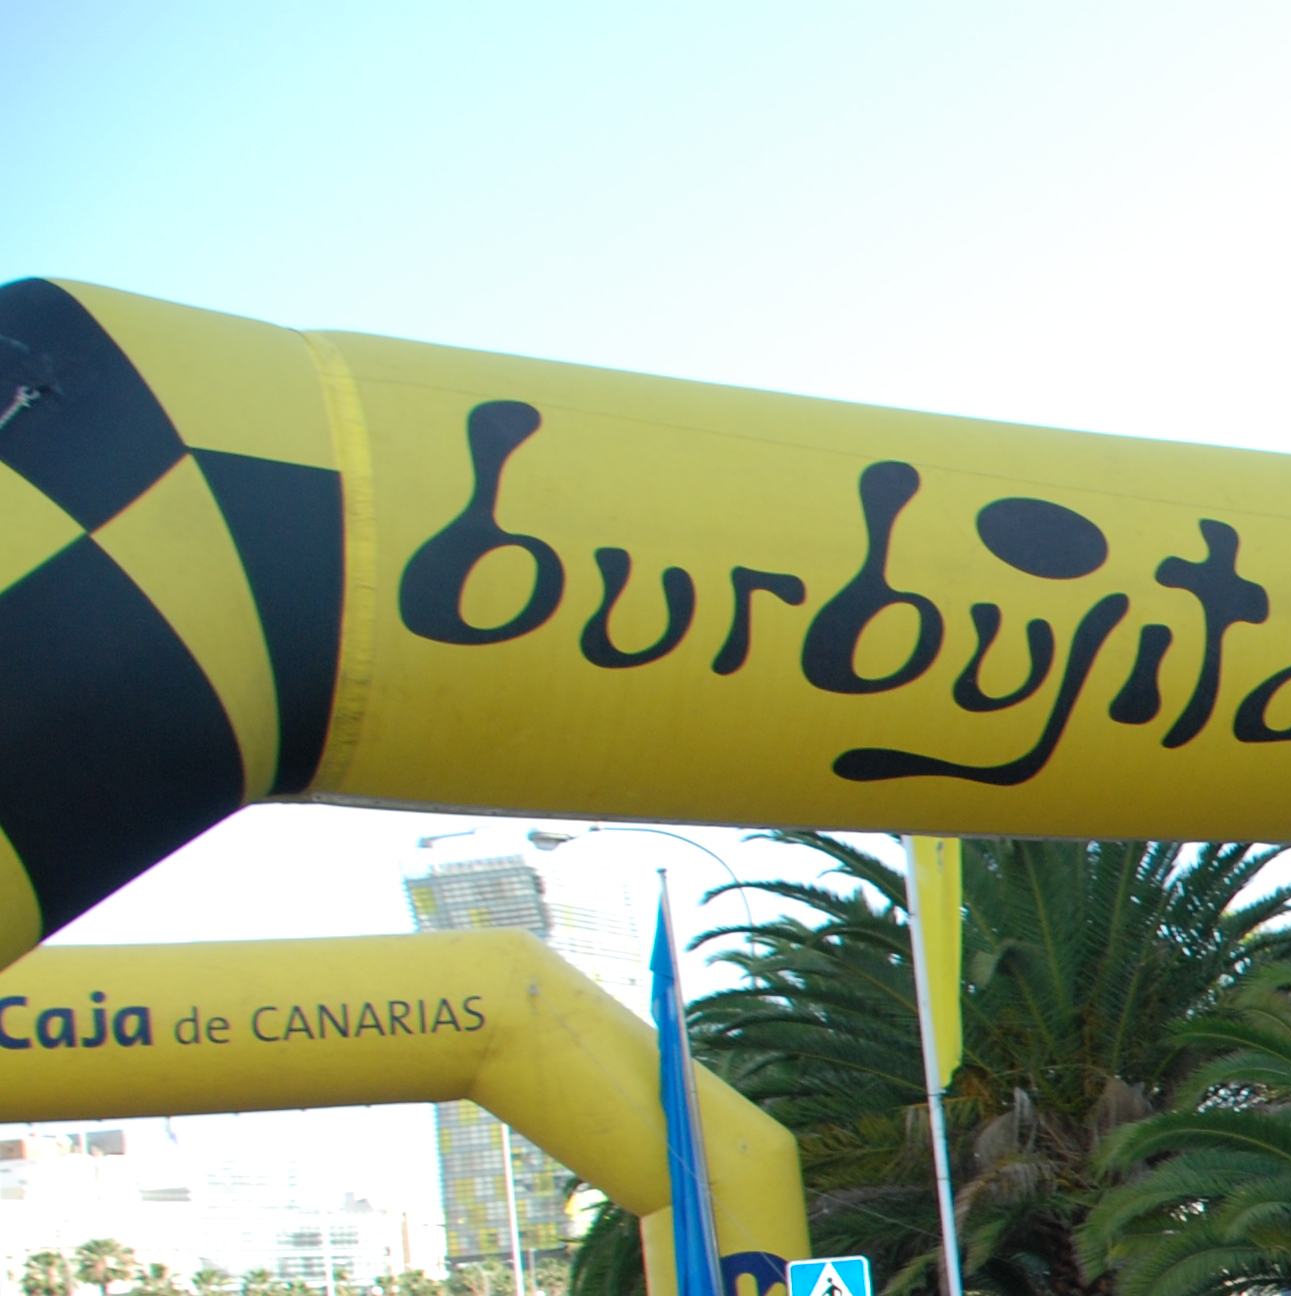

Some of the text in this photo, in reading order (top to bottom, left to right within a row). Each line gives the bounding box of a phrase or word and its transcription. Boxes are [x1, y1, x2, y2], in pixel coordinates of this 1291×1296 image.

[0, 991, 486, 1050] Caja de CANARIAS
